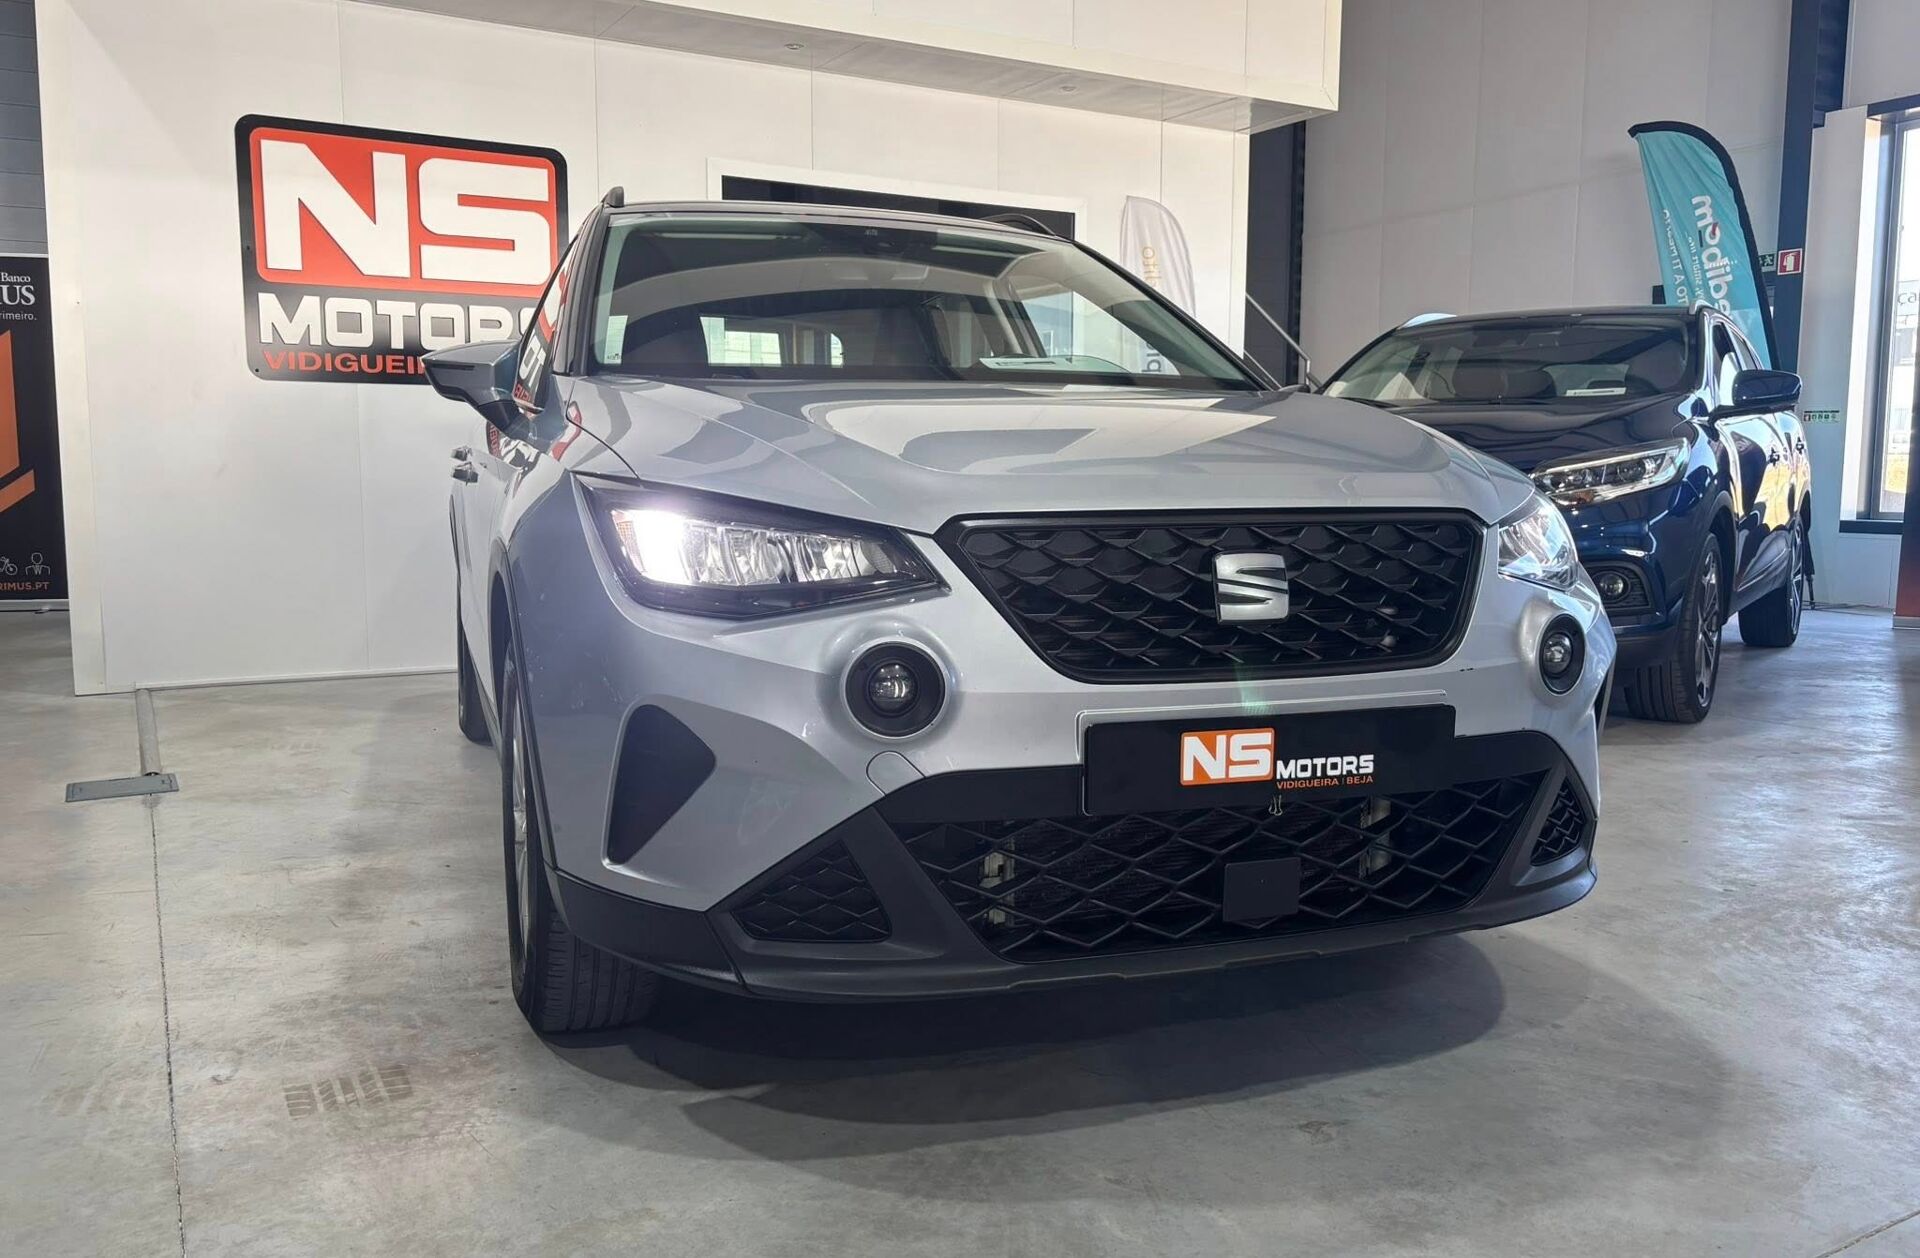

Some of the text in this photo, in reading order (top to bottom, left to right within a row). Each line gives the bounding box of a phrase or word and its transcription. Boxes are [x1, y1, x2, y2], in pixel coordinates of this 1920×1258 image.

[259, 138, 551, 287] NS
[0, 272, 31, 283] Banco
[258, 292, 536, 352] MOTOR
[263, 350, 425, 375] VIDIGUEI
[1183, 732, 1273, 781] NS
[1276, 754, 1375, 779] MOTORS
[1276, 775, 1374, 790] VIDIGUEIRA BEJA
